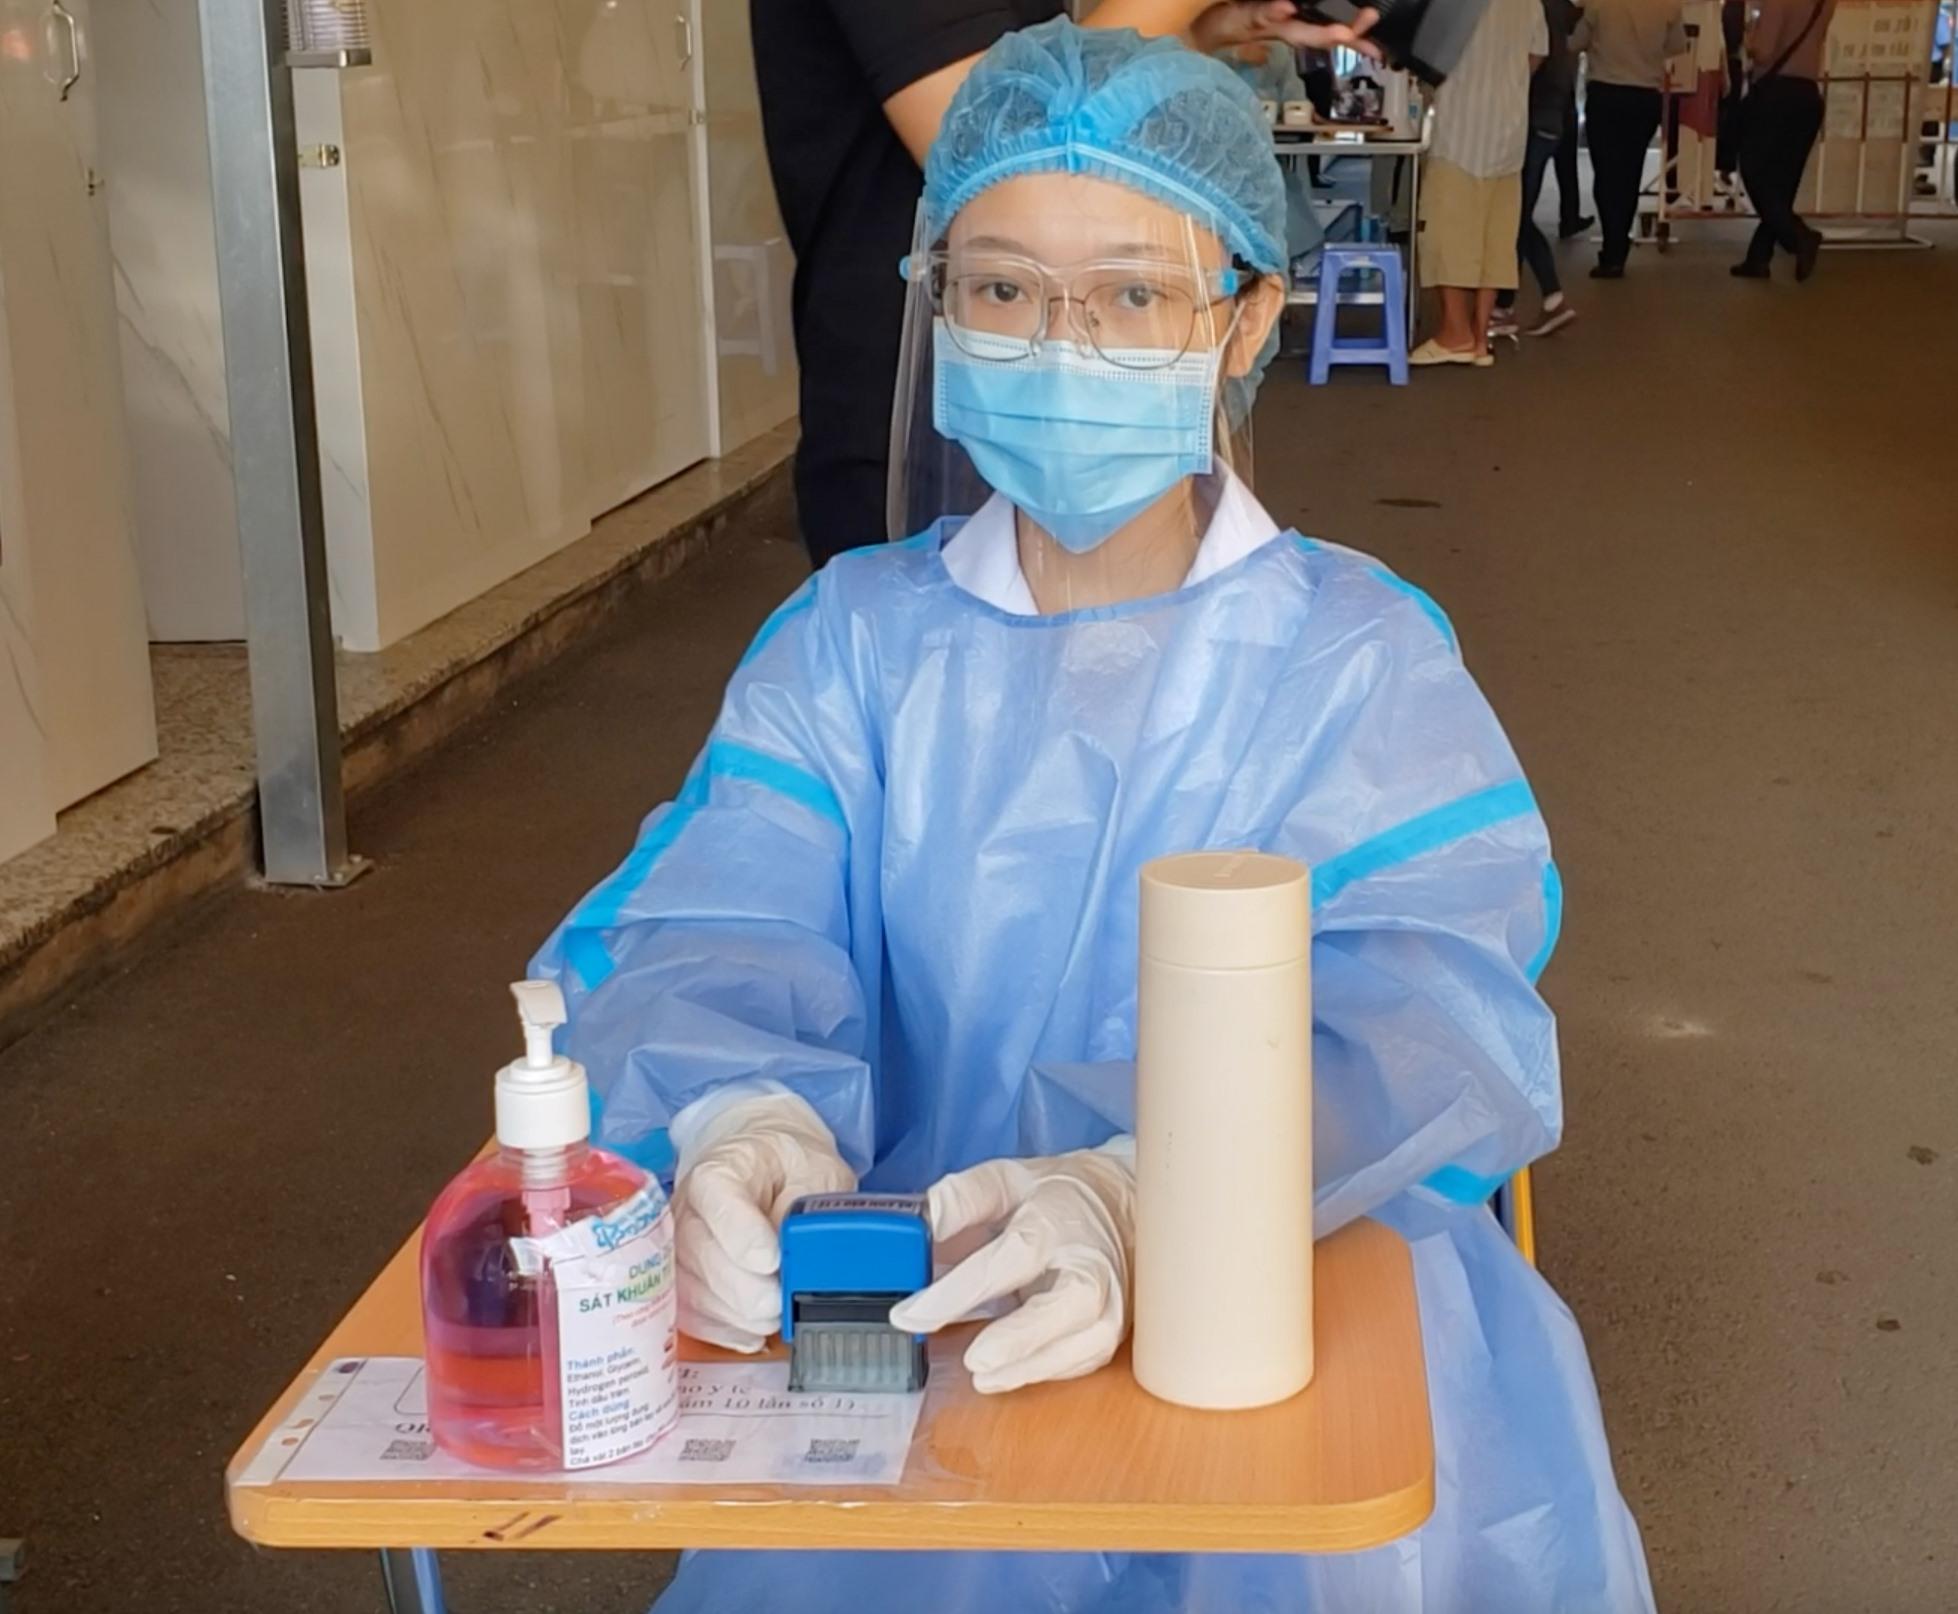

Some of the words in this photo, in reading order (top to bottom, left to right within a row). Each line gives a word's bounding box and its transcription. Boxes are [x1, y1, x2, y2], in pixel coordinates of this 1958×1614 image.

[579, 1291, 612, 1313] SÁT
[568, 1379, 616, 1397] Hydrogen
[568, 1408, 599, 1421] Cách
